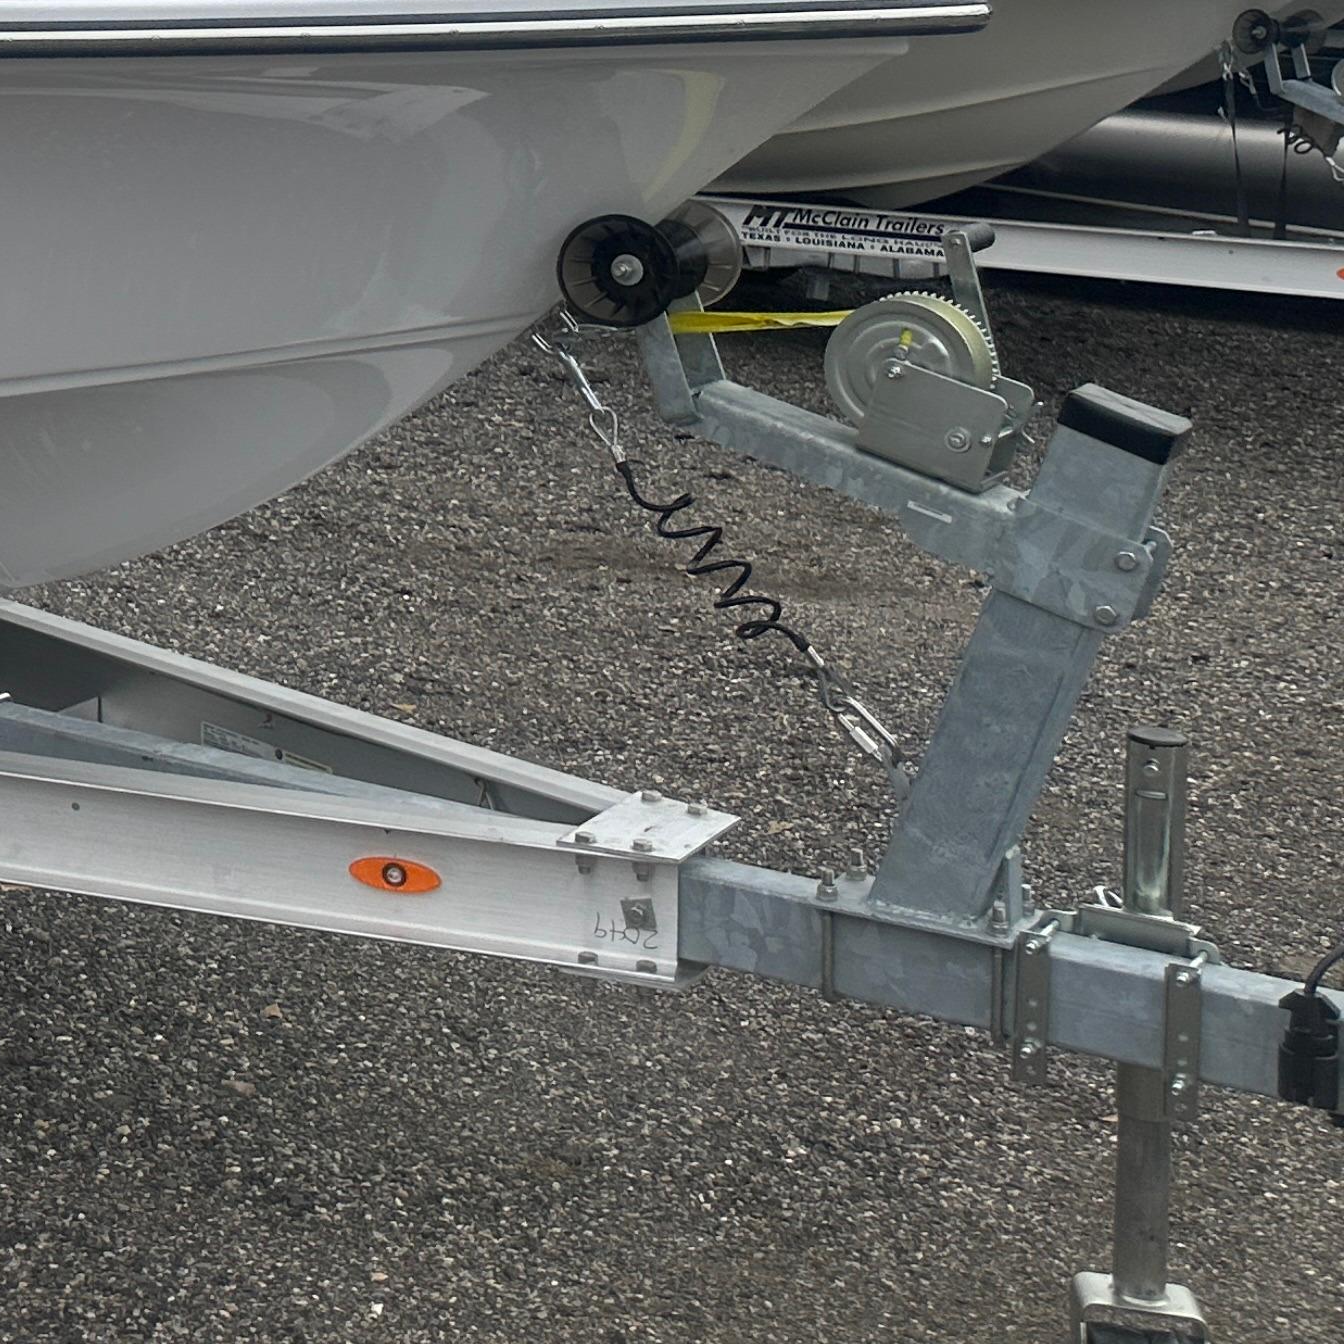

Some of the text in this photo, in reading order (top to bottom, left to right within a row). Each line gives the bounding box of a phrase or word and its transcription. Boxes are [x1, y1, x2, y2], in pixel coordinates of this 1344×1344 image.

[792, 209, 869, 230] McClain
[875, 215, 944, 236] Trailers
[742, 231, 945, 257] TEXAS LOUISIANA ALABAMA
